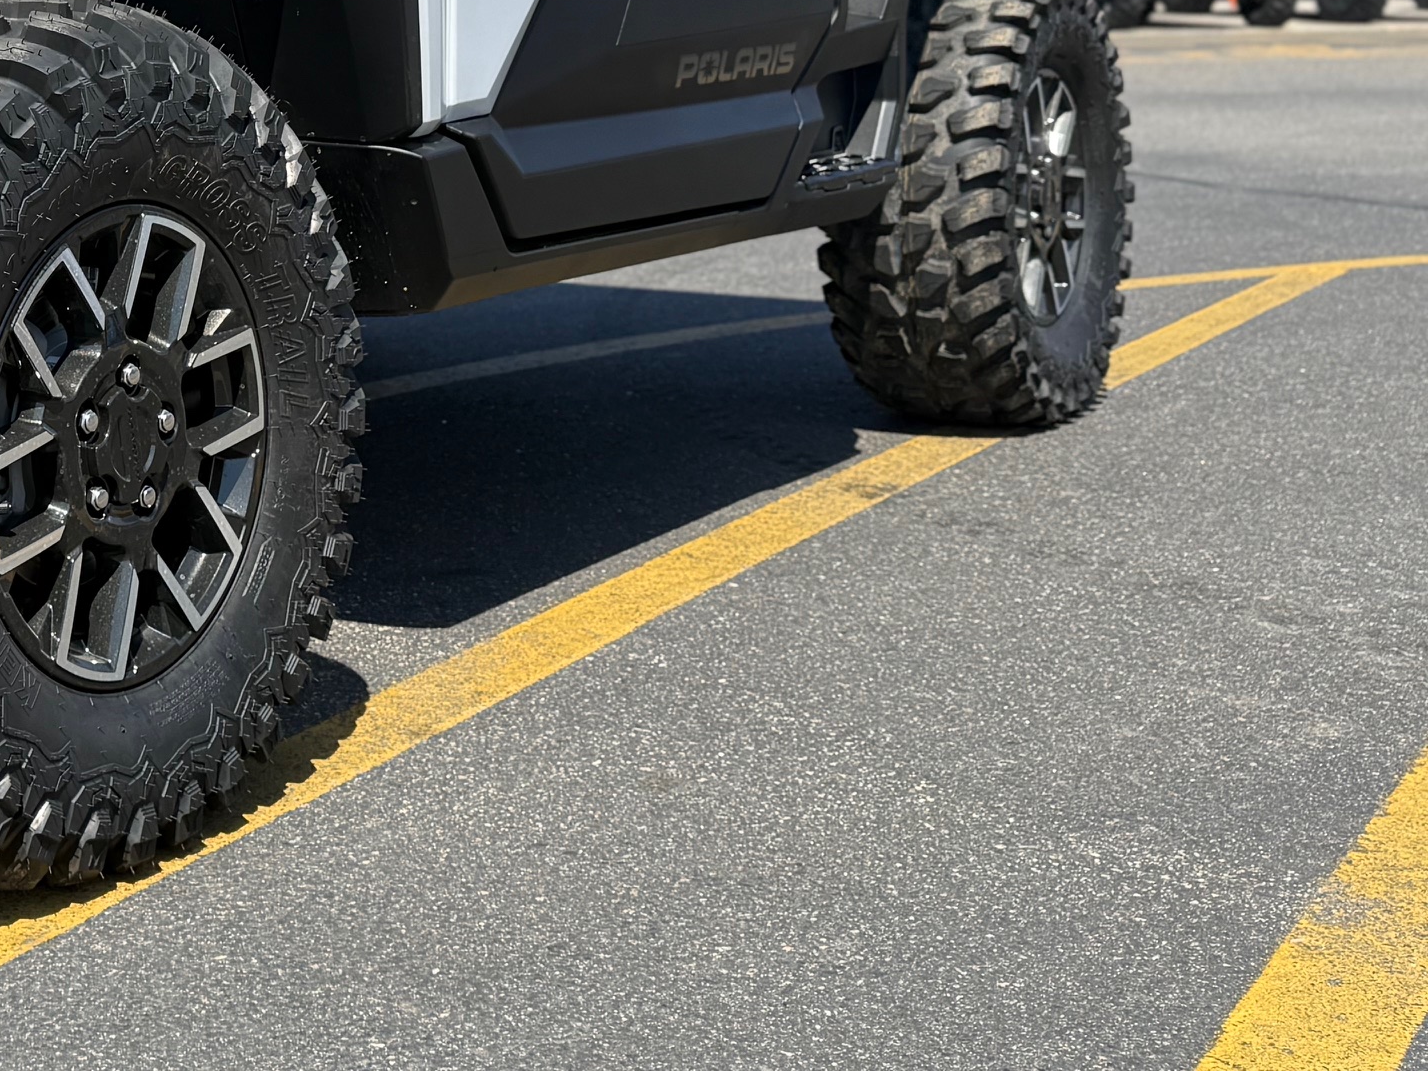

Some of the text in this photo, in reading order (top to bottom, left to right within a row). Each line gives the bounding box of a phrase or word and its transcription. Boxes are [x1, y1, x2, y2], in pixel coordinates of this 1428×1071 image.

[675, 41, 797, 88] POLARIS
[156, 154, 310, 419] CROSS TRAIL
